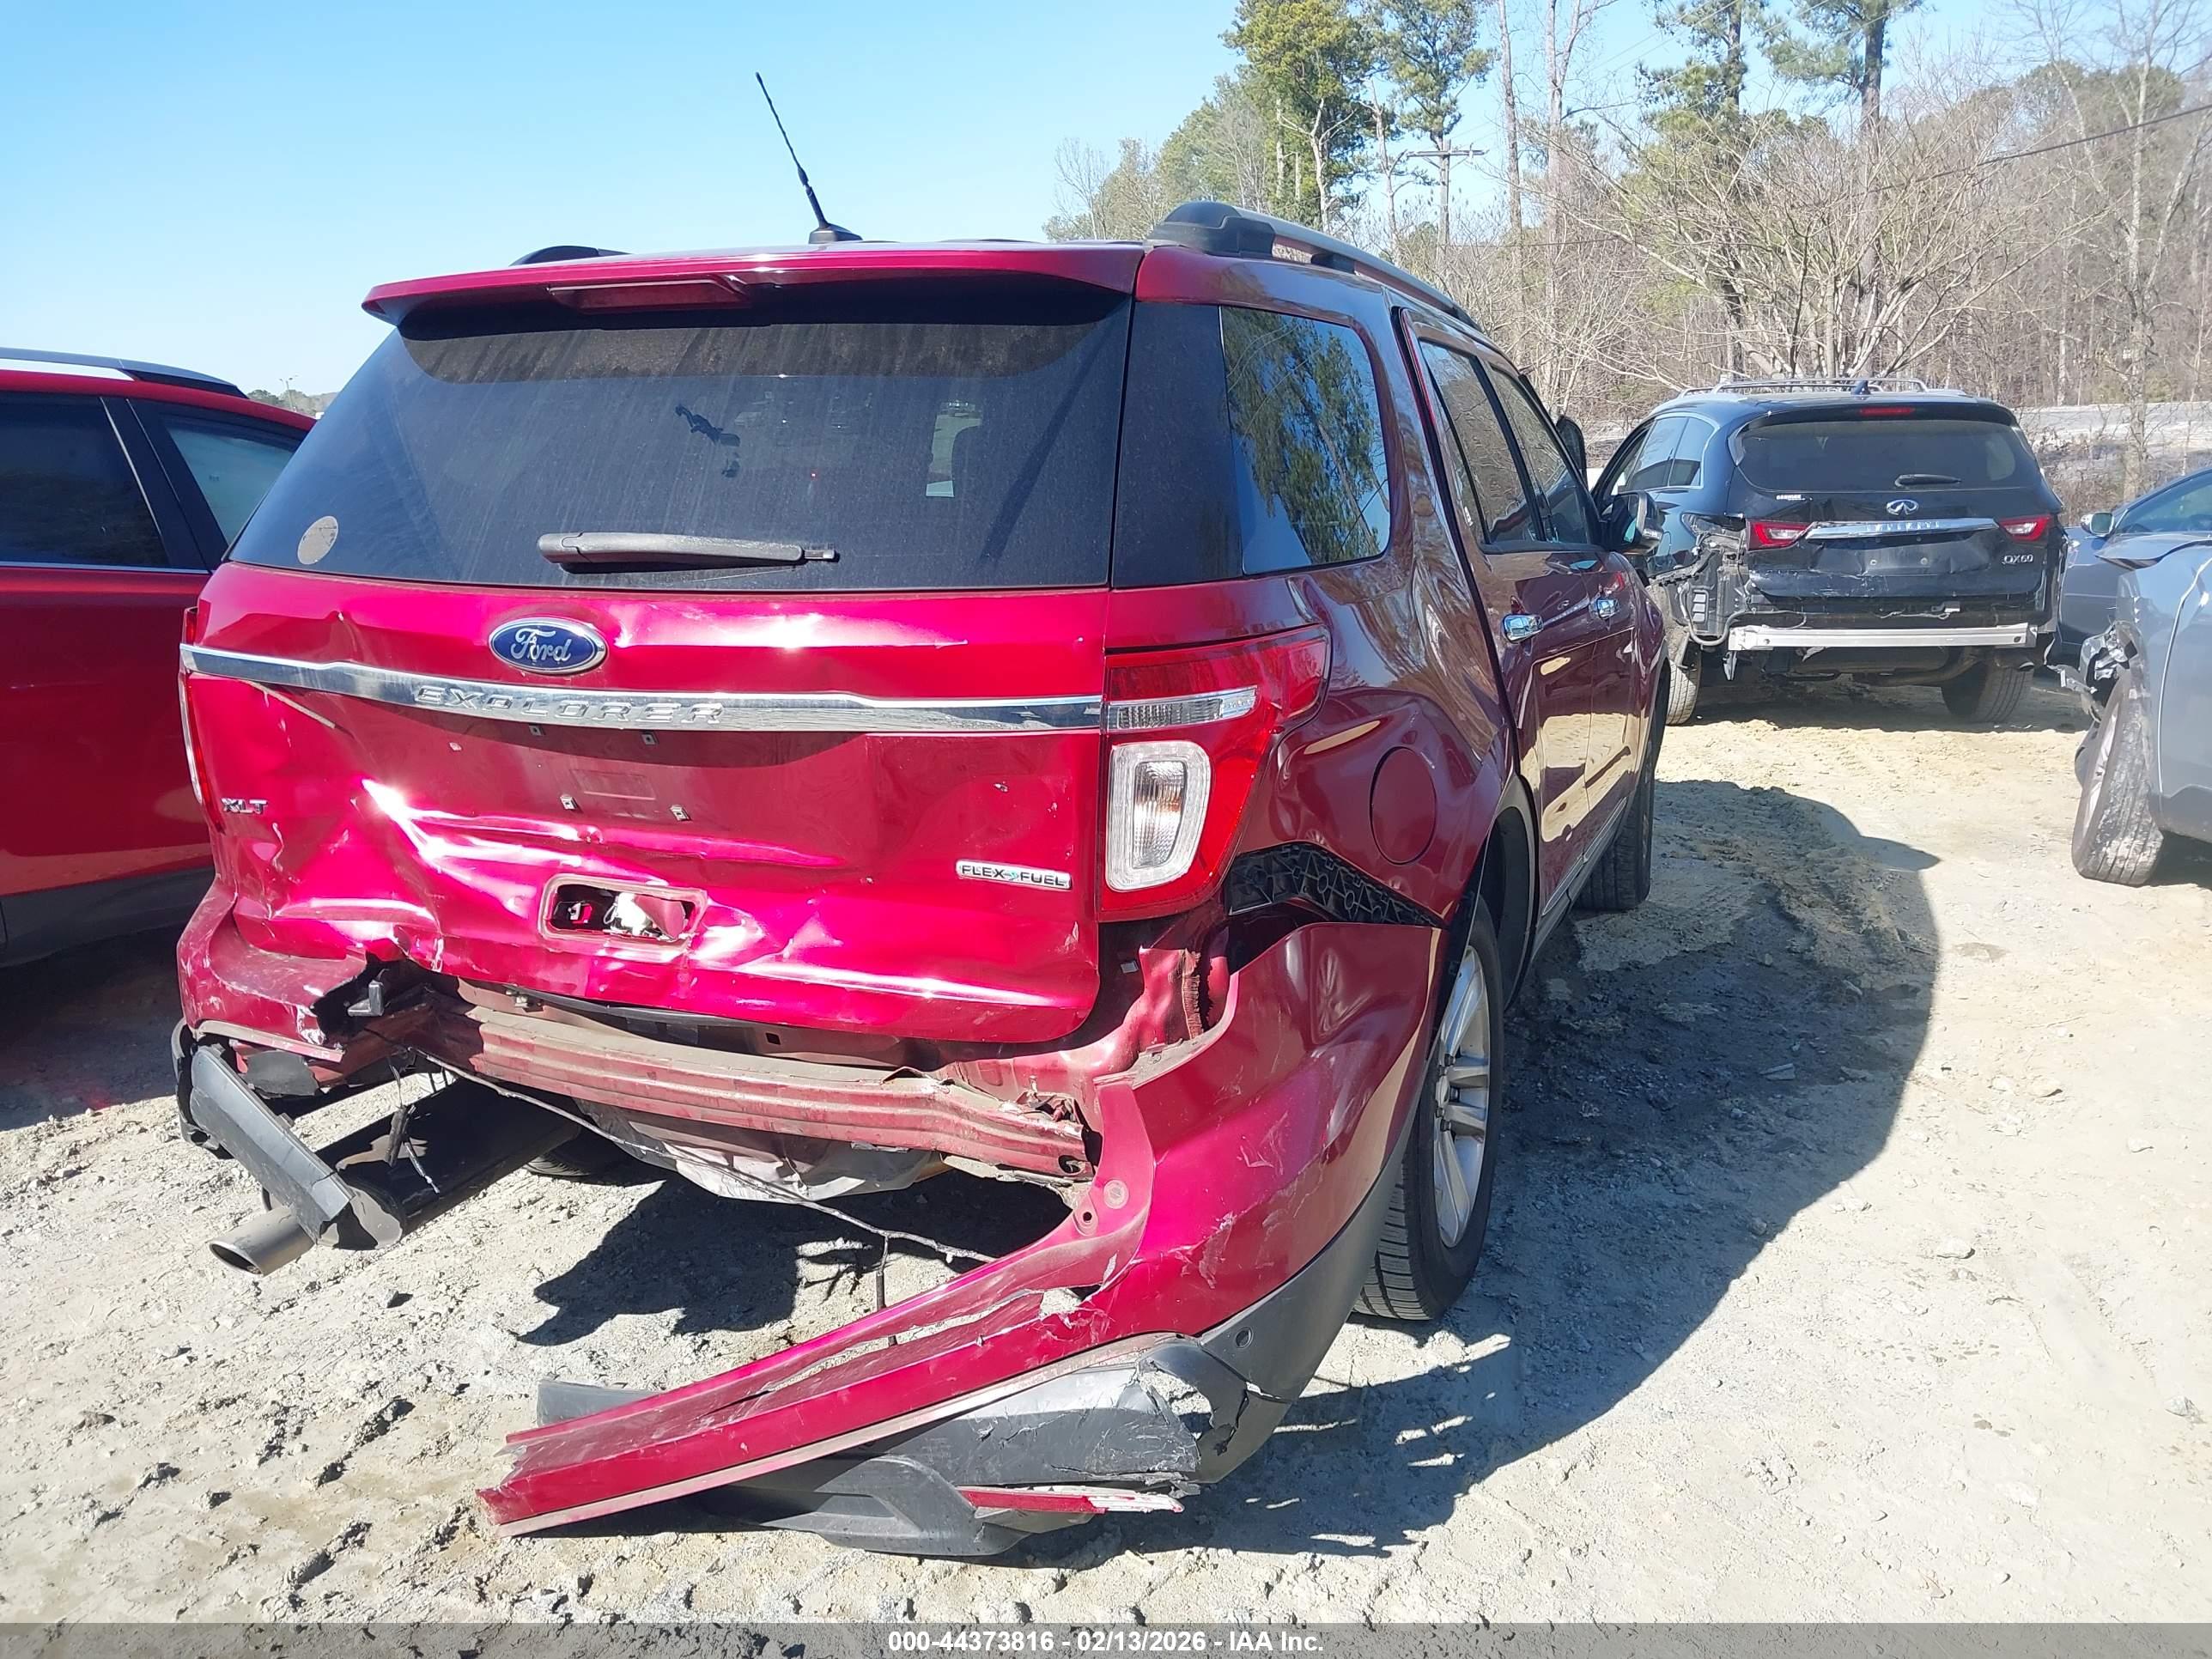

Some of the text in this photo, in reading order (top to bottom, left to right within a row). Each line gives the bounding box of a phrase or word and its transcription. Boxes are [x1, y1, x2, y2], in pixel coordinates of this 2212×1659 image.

[510, 627, 572, 663] Ford
[415, 684, 724, 725] EXPLORER
[221, 798, 268, 815] XLT
[961, 865, 1065, 887] FLEX FUEL
